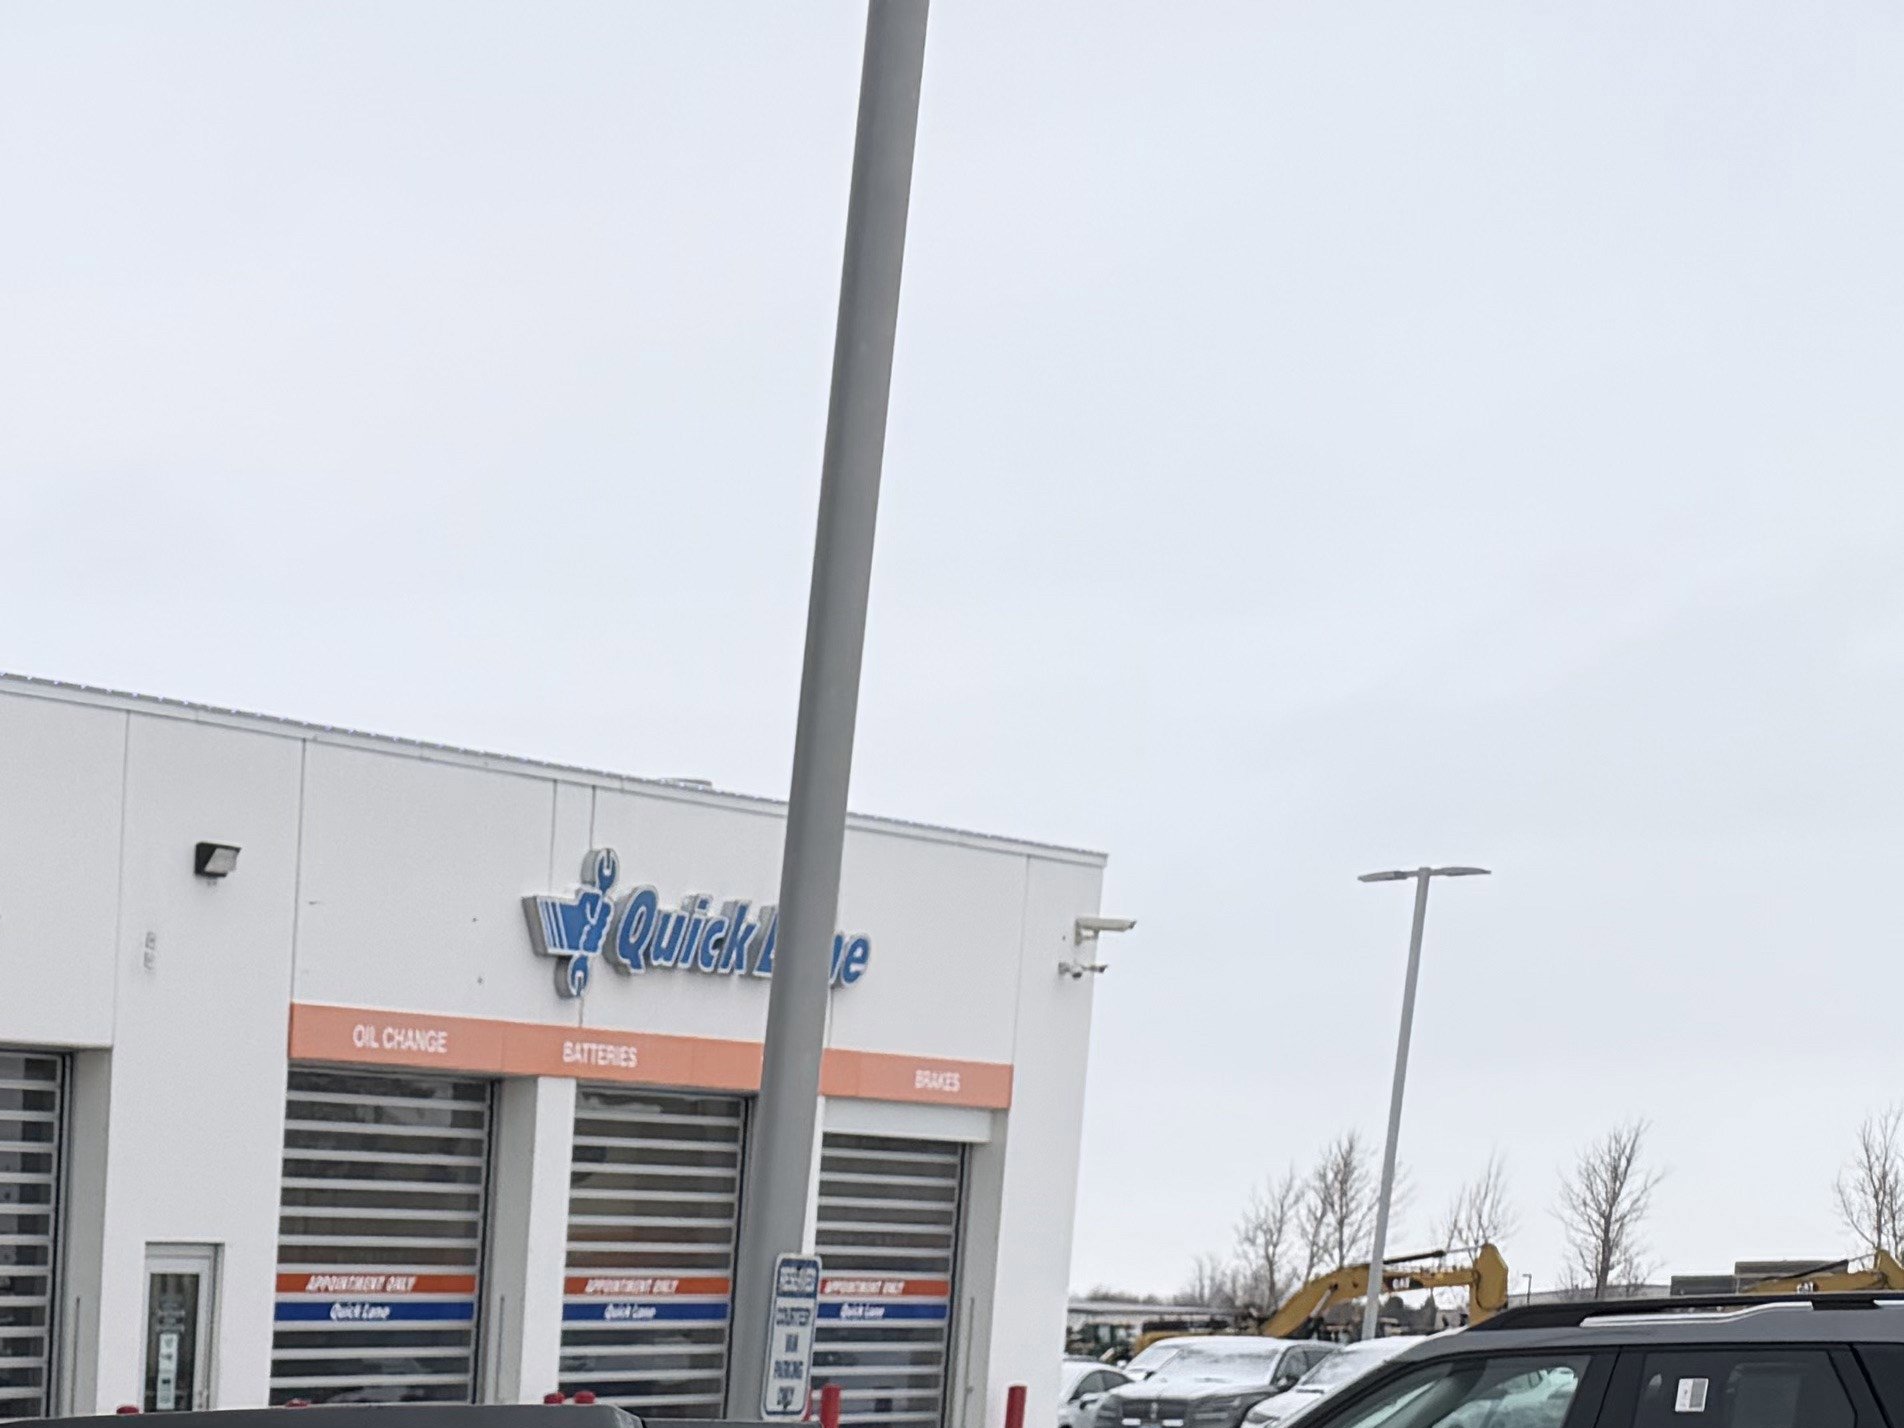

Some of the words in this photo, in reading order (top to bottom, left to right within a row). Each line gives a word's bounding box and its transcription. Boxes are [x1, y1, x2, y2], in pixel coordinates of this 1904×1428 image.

[615, 885, 759, 976] Quick
[753, 907, 871, 987] Le
[352, 1024, 379, 1049] OIL
[382, 1028, 449, 1053] CHANGE
[562, 1041, 639, 1068] BATTERIES
[914, 1069, 961, 1092] BRAKES
[305, 1274, 386, 1292] APPOINTMENT
[329, 1302, 361, 1320] Quick
[361, 1303, 390, 1319] Lane
